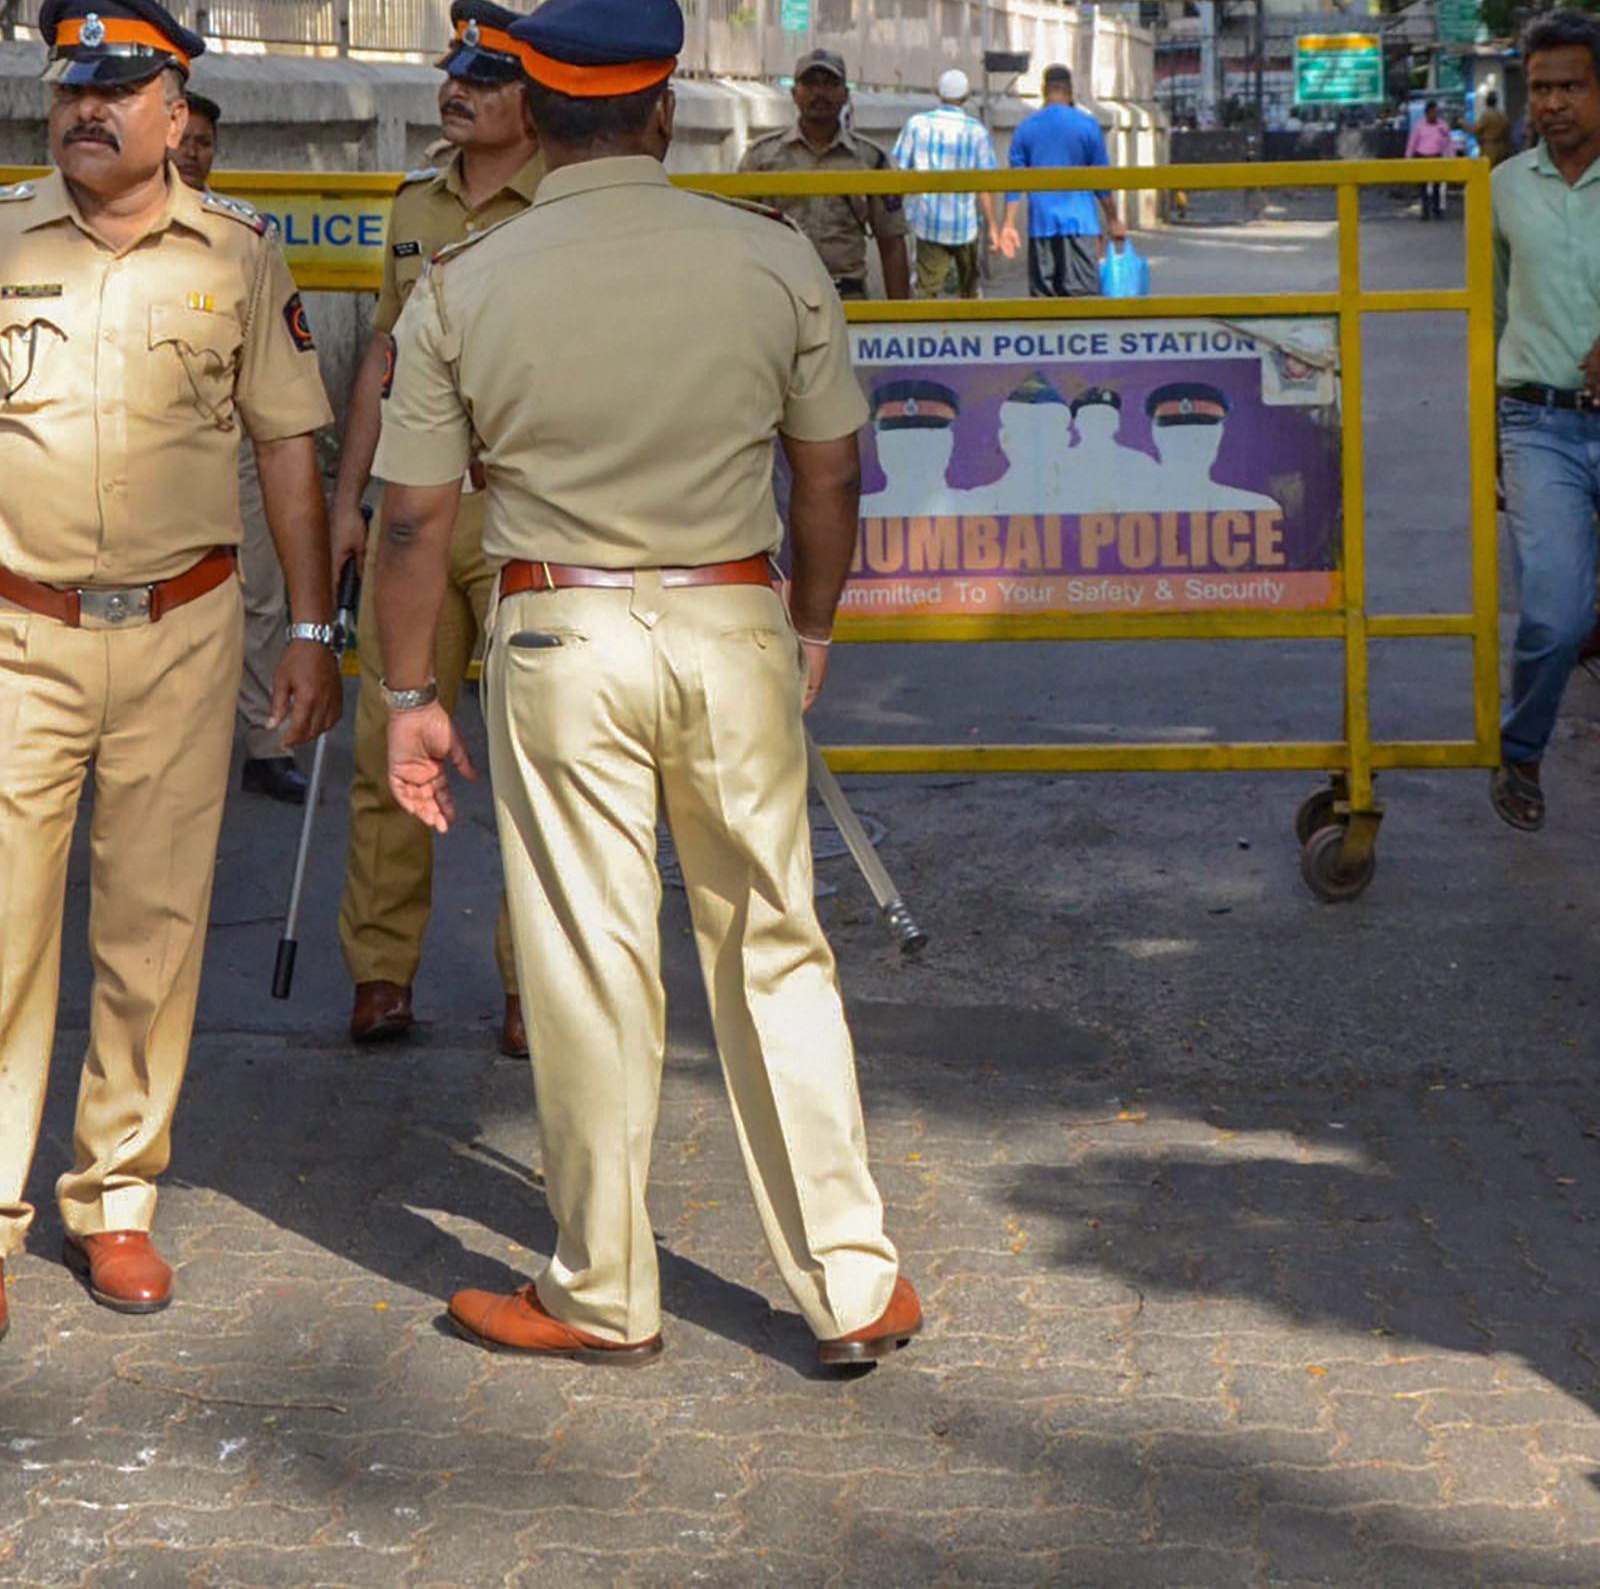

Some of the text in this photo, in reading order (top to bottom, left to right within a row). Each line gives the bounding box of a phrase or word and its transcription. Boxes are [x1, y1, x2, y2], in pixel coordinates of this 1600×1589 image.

[266, 213, 383, 246] LICE
[857, 331, 1257, 359] MAIDAN POLICE STATION
[850, 509, 1285, 574] UMBAI POLICE
[838, 581, 942, 606] ommitted
[952, 581, 987, 605] To
[997, 581, 1055, 604] Your
[1154, 579, 1175, 602] &
[1183, 578, 1285, 603] Security
